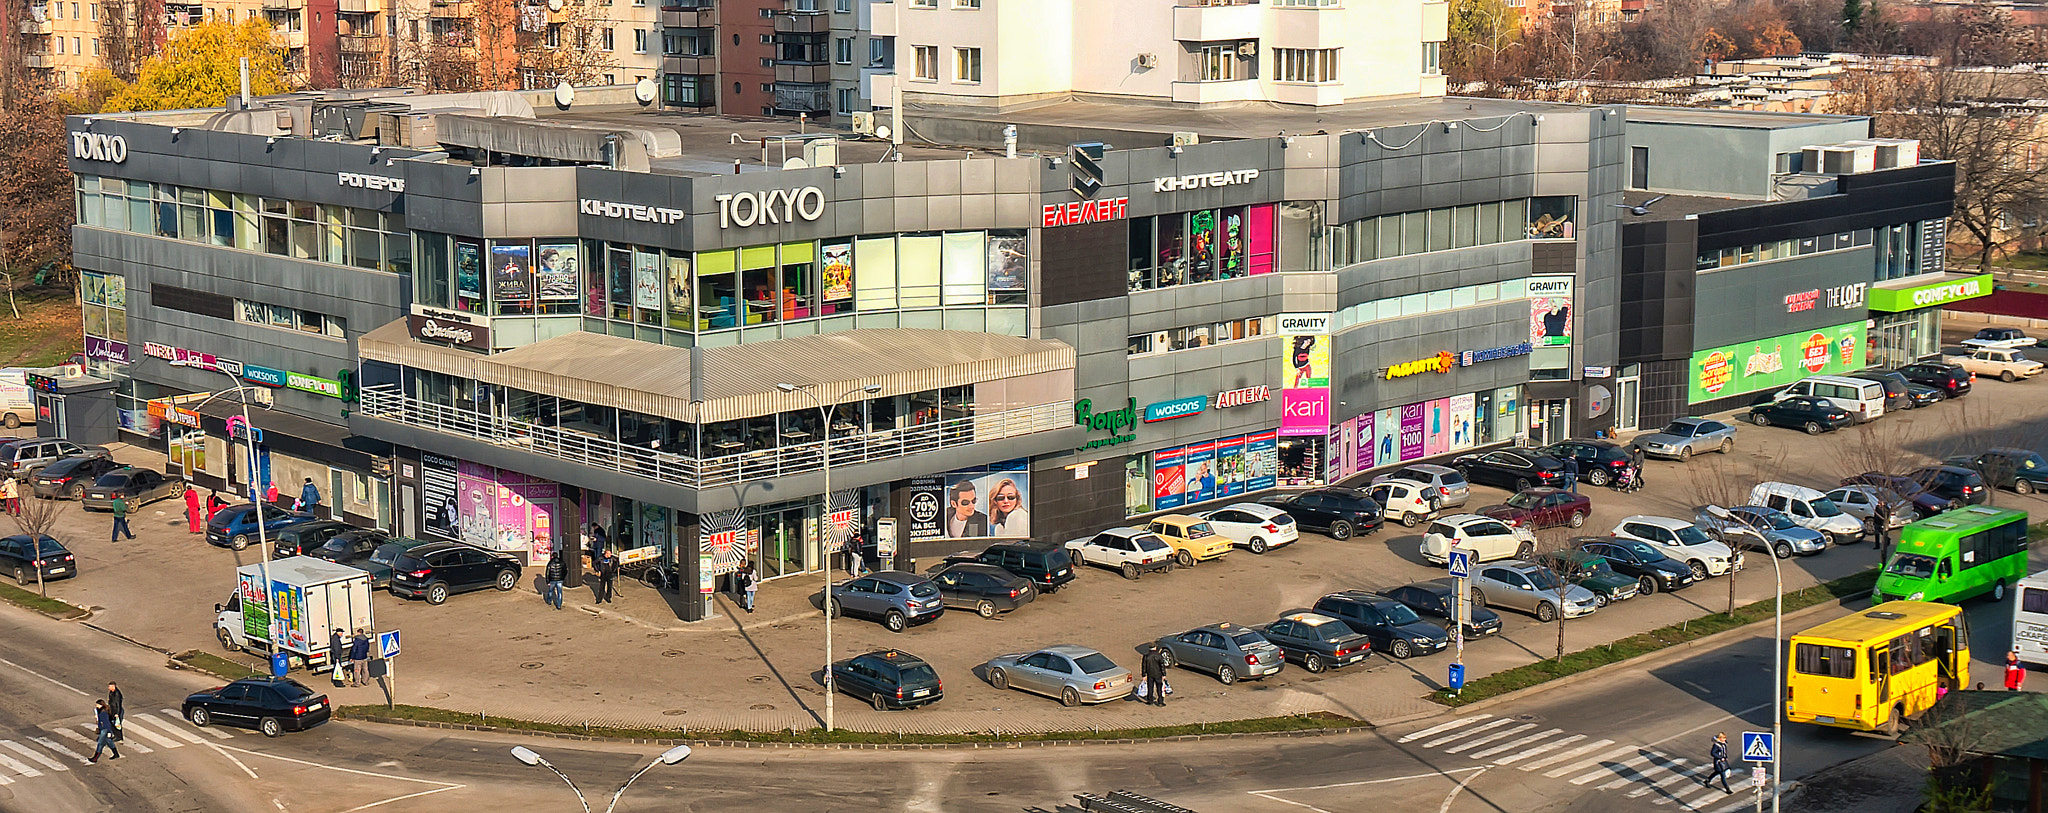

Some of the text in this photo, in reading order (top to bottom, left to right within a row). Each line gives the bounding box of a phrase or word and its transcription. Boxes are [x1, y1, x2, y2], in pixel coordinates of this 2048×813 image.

[72, 131, 127, 164] TOKYO
[1154, 169, 1260, 193] КІНОТЕАТР
[580, 198, 684, 224] КІНОТЕАТР
[715, 186, 825, 229] TOKYO
[1042, 196, 1128, 228] ЕЛЕМЕНТ
[1529, 281, 1569, 291] GRAVITY
[1826, 286, 1840, 308] THE
[1840, 282, 1867, 306] LOFT
[1282, 318, 1326, 328] GRAVITY
[1809, 346, 1823, 357] БЕЗ
[247, 368, 279, 383] watsons
[1216, 385, 1271, 409] АПТЕКА
[1155, 400, 1200, 416] watsons
[1284, 395, 1324, 417] kari
[1402, 404, 1422, 419] kari
[1402, 432, 1422, 447] 1000
[423, 454, 439, 464] COCO
[911, 501, 937, 512] -70%
[831, 511, 851, 523] SALE
[912, 522, 923, 530] НА
[709, 531, 736, 547] SALE
